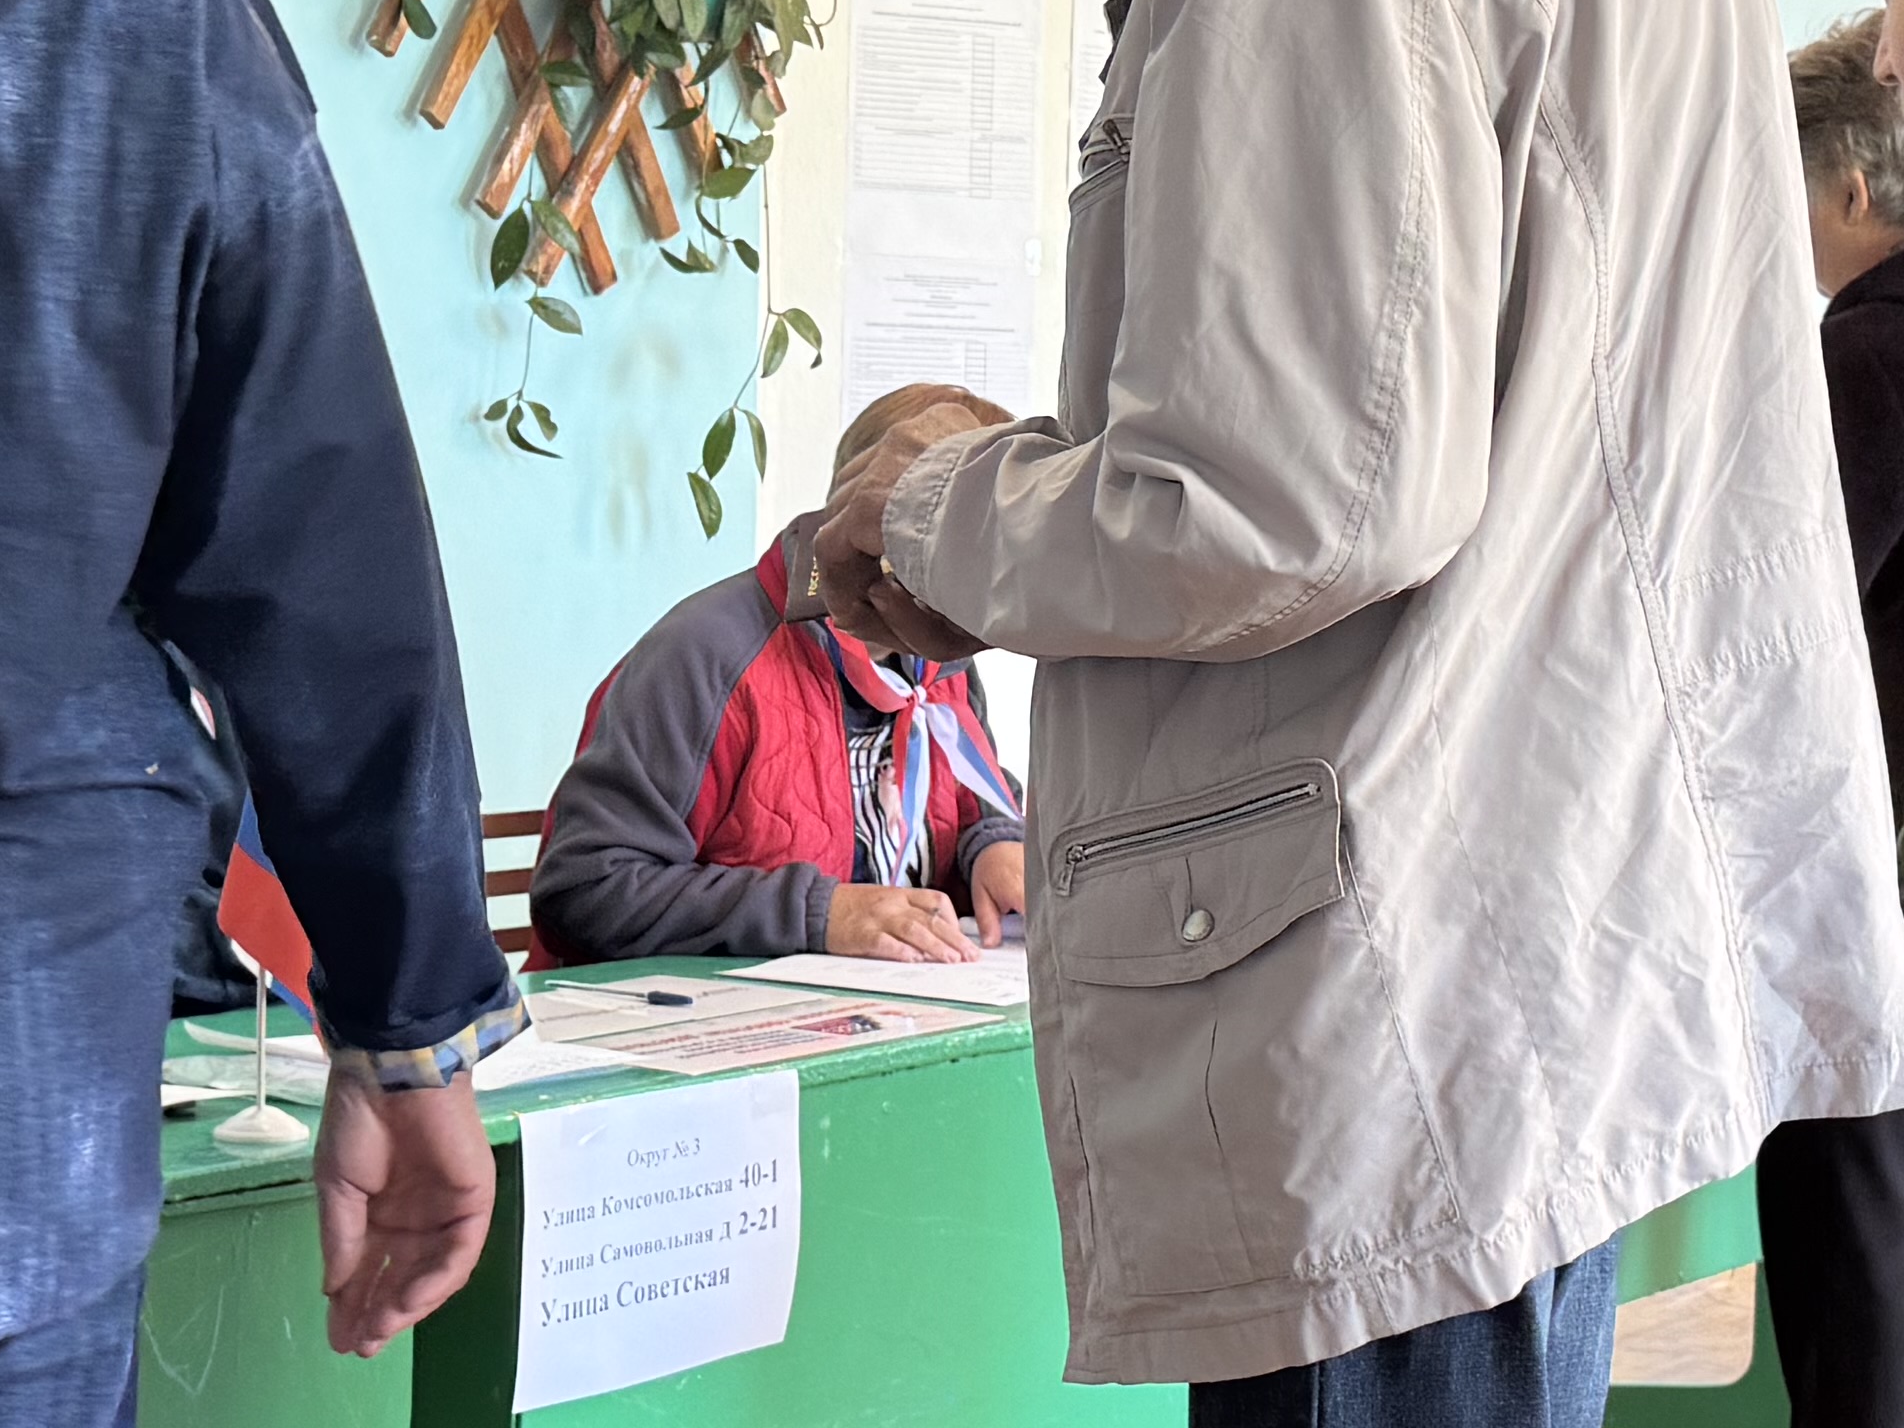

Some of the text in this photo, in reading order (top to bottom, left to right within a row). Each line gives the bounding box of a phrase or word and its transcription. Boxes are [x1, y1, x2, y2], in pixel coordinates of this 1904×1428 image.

[626, 1138, 701, 1169] Округ № 3
[543, 1159, 778, 1230] Улица Комсомольская 40-1
[541, 1253, 594, 1278] Улица
[738, 1204, 778, 1236] 2-21
[540, 1266, 732, 1328] Улица Советская
